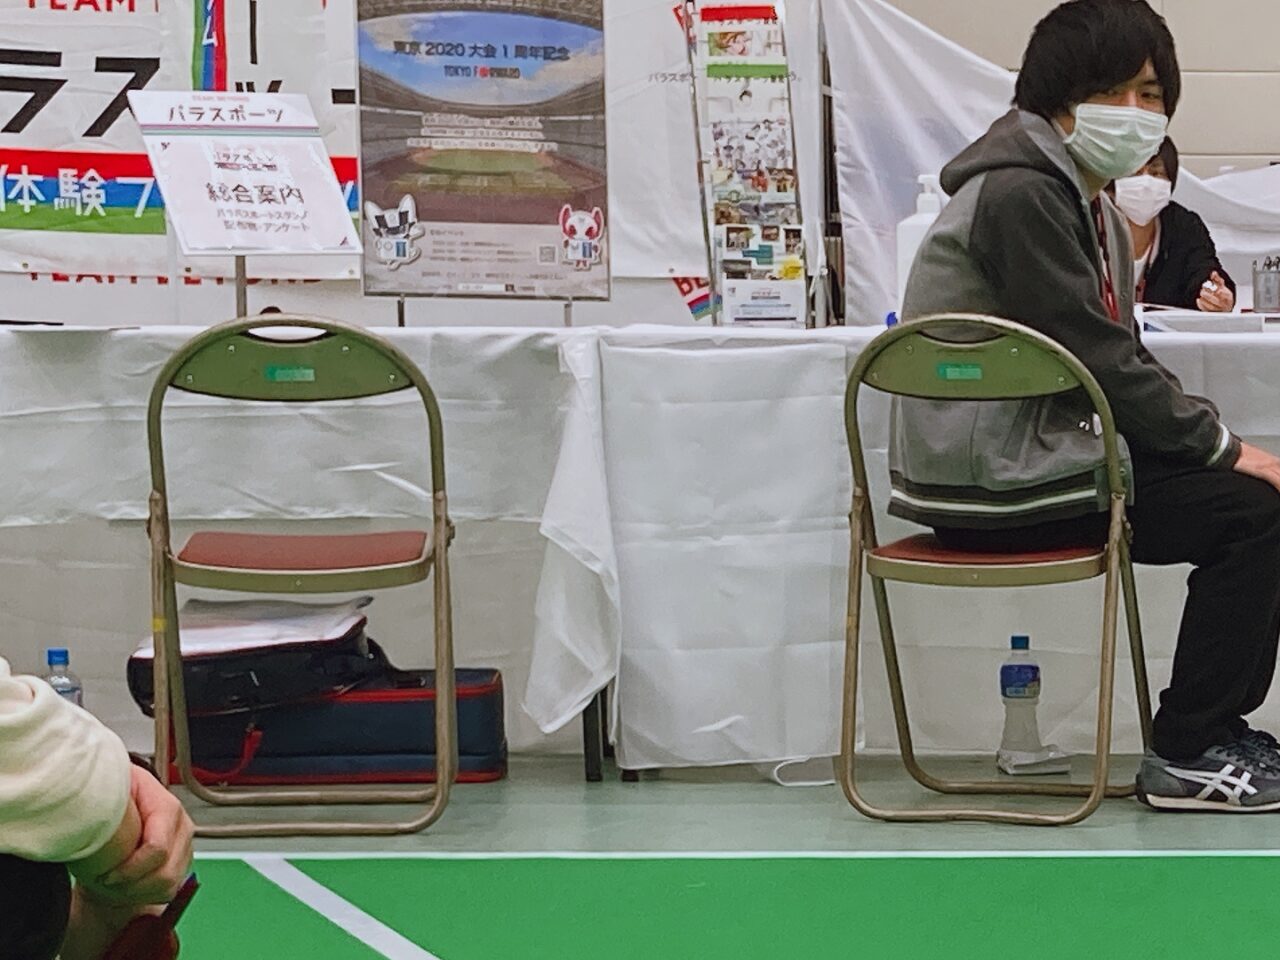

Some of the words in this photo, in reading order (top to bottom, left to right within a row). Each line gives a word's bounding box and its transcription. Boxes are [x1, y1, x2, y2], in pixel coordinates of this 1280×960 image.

[425, 41, 465, 57] 2020
[468, 43, 497, 59] 大会
[444, 65, 472, 78] TOKYO
[168, 104, 284, 123] パラスポーツ
[206, 182, 305, 205] 総合案内
